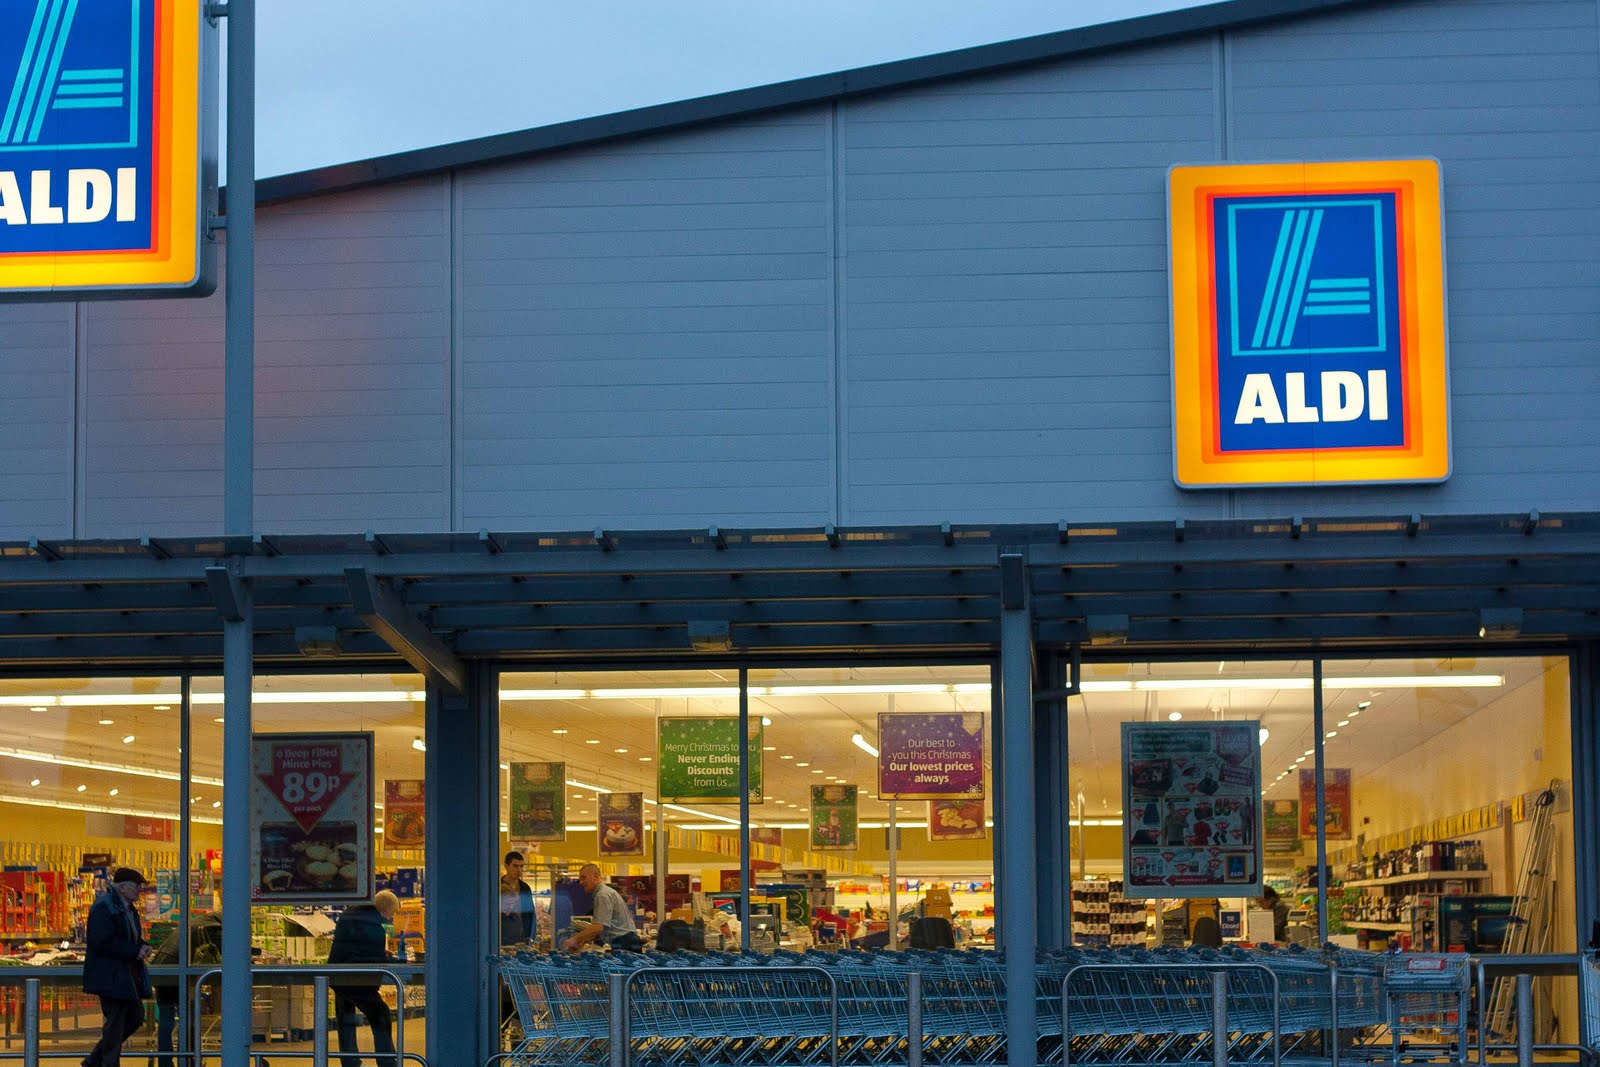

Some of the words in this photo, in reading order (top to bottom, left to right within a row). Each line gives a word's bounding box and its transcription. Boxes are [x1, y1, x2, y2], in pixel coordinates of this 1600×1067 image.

[0, 167, 136, 225] ALDI
[1234, 369, 1388, 425] ALDI
[665, 743, 688, 753] Merry
[689, 742, 729, 752] Christmas
[731, 743, 739, 752] to
[908, 739, 926, 748] Our
[926, 739, 944, 748] best
[946, 739, 955, 748] to
[285, 749, 309, 759] Deep
[312, 747, 337, 757] Filled
[678, 754, 707, 763] Never
[892, 752, 909, 761] you
[911, 750, 926, 760] this
[927, 749, 971, 760] Christmas
[282, 759, 310, 769] Mince
[312, 758, 332, 768] Pies
[889, 762, 907, 771] Our
[909, 761, 942, 771] lowest
[945, 761, 974, 773] prices
[687, 765, 734, 775] Discounts
[693, 776, 715, 787] from
[716, 778, 728, 787] us
[914, 773, 949, 784] always
[282, 772, 340, 803] 89p
[294, 805, 305, 813] per
[306, 804, 322, 812] pack
